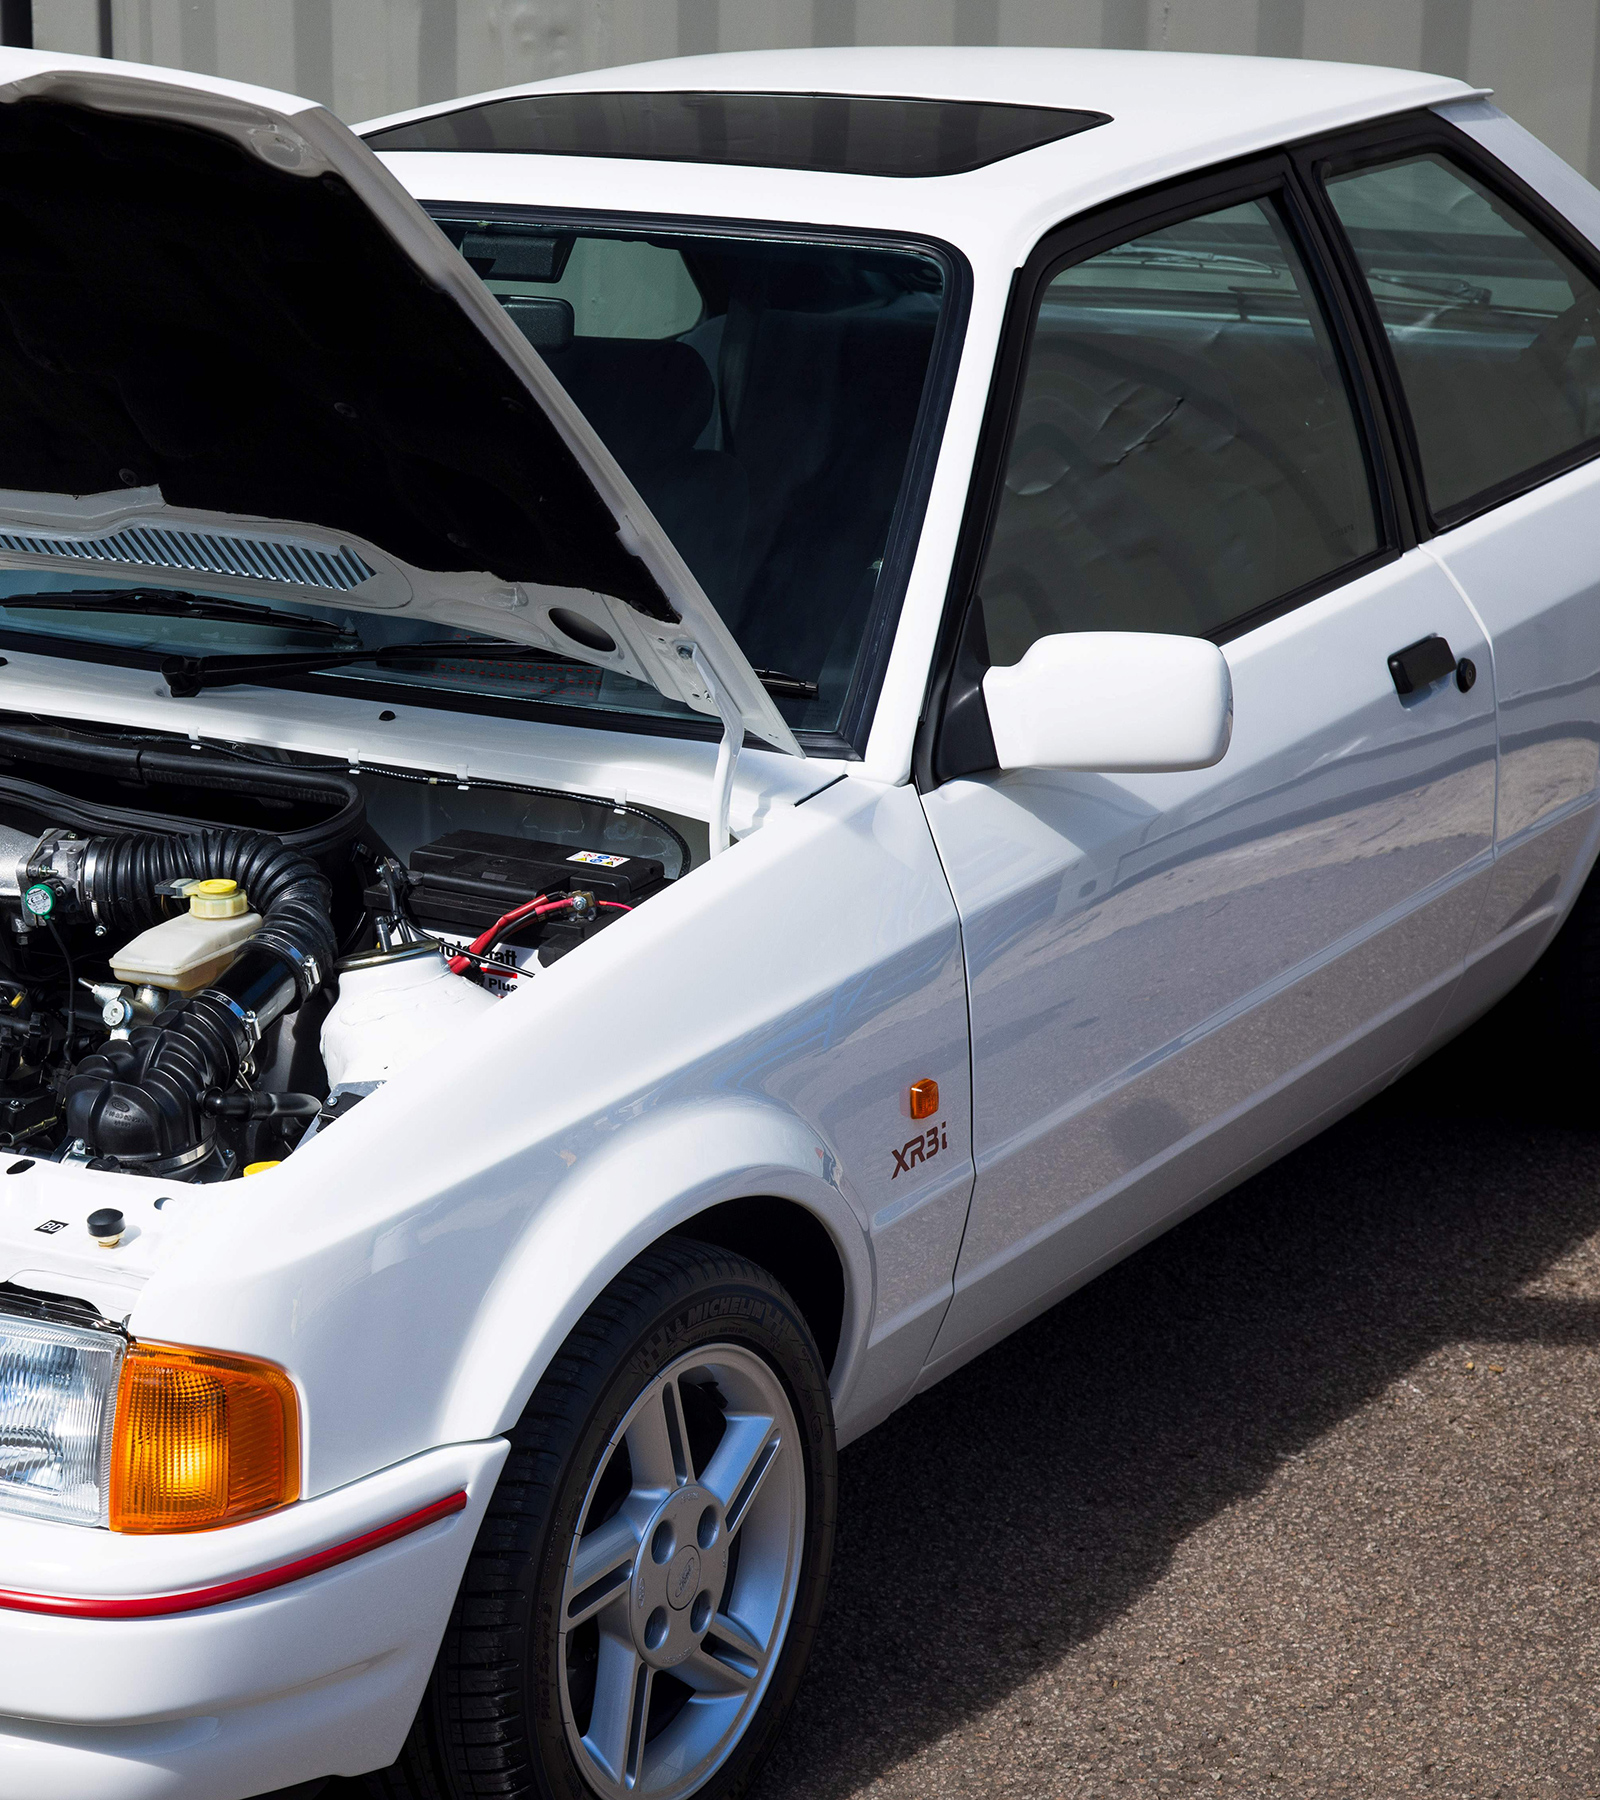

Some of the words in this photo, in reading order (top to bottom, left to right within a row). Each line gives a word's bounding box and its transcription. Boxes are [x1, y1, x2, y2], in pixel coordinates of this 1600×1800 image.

[891, 1121, 947, 1180] XR3i
[40, 1222, 64, 1232] BD
[687, 1297, 767, 1327] MICHELIN
